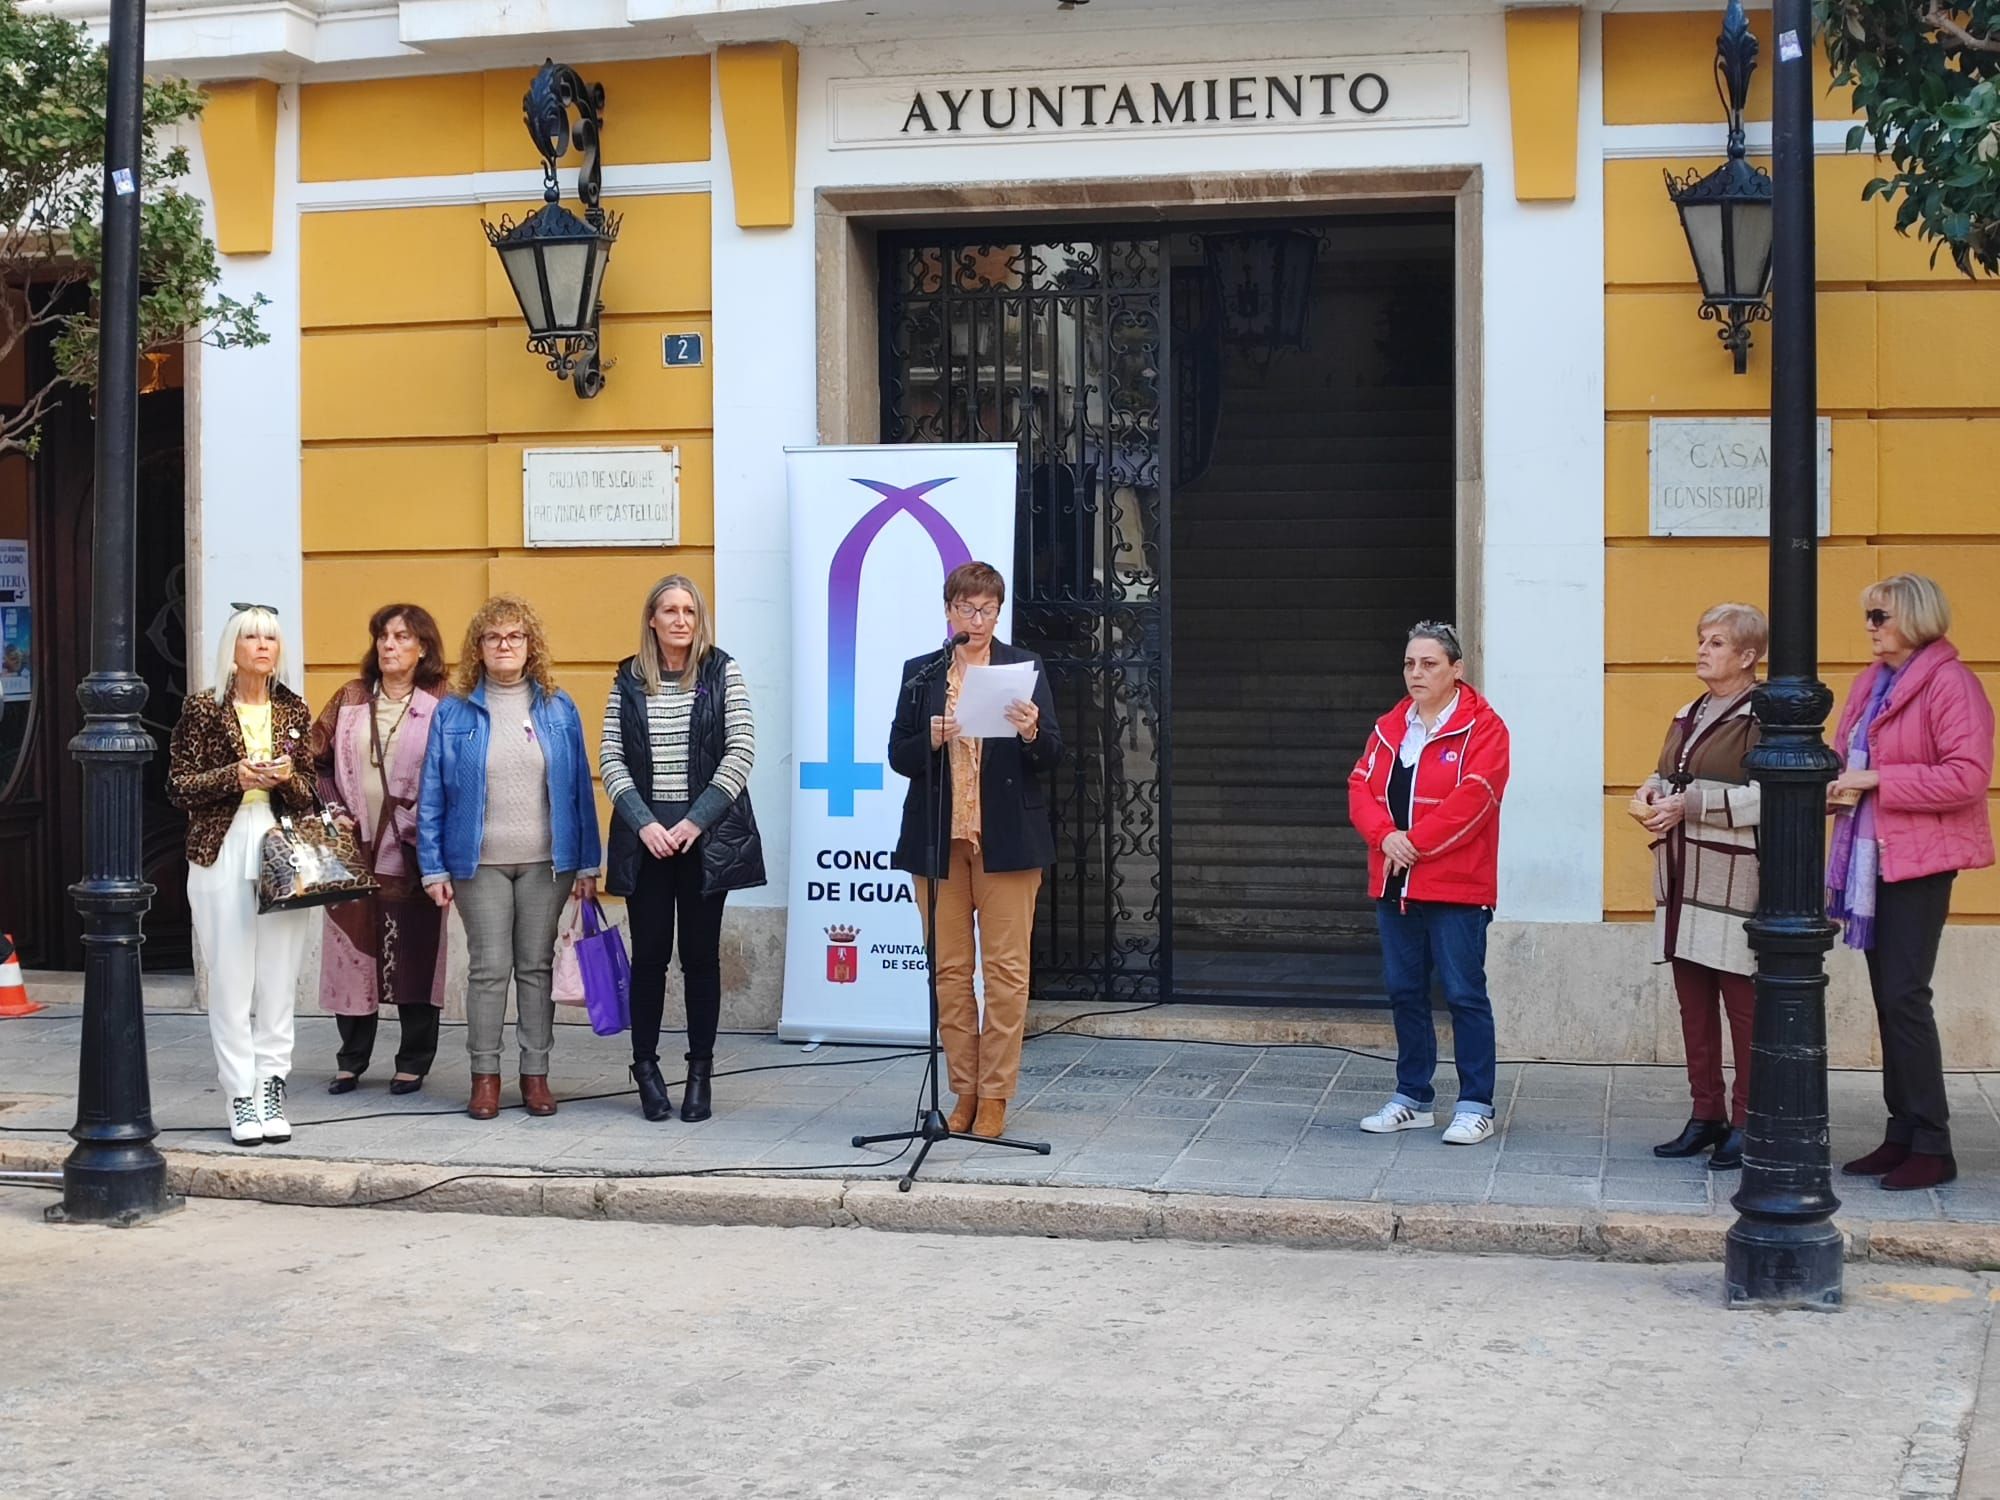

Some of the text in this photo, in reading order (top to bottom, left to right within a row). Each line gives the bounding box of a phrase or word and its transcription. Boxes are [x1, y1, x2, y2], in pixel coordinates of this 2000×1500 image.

[900, 72, 1389, 132] AYUNTAMIENTO
[678, 339, 689, 359] 2
[1690, 443, 1769, 469] CASA
[592, 471, 605, 488] DE
[1664, 486, 1770, 509] CONSISTORI
[534, 504, 586, 522] PROVINCIA
[590, 504, 603, 521] DE
[0, 576, 26, 588] TERIA
[808, 882, 917, 903] DE IGUA
[882, 959, 898, 970] DE
